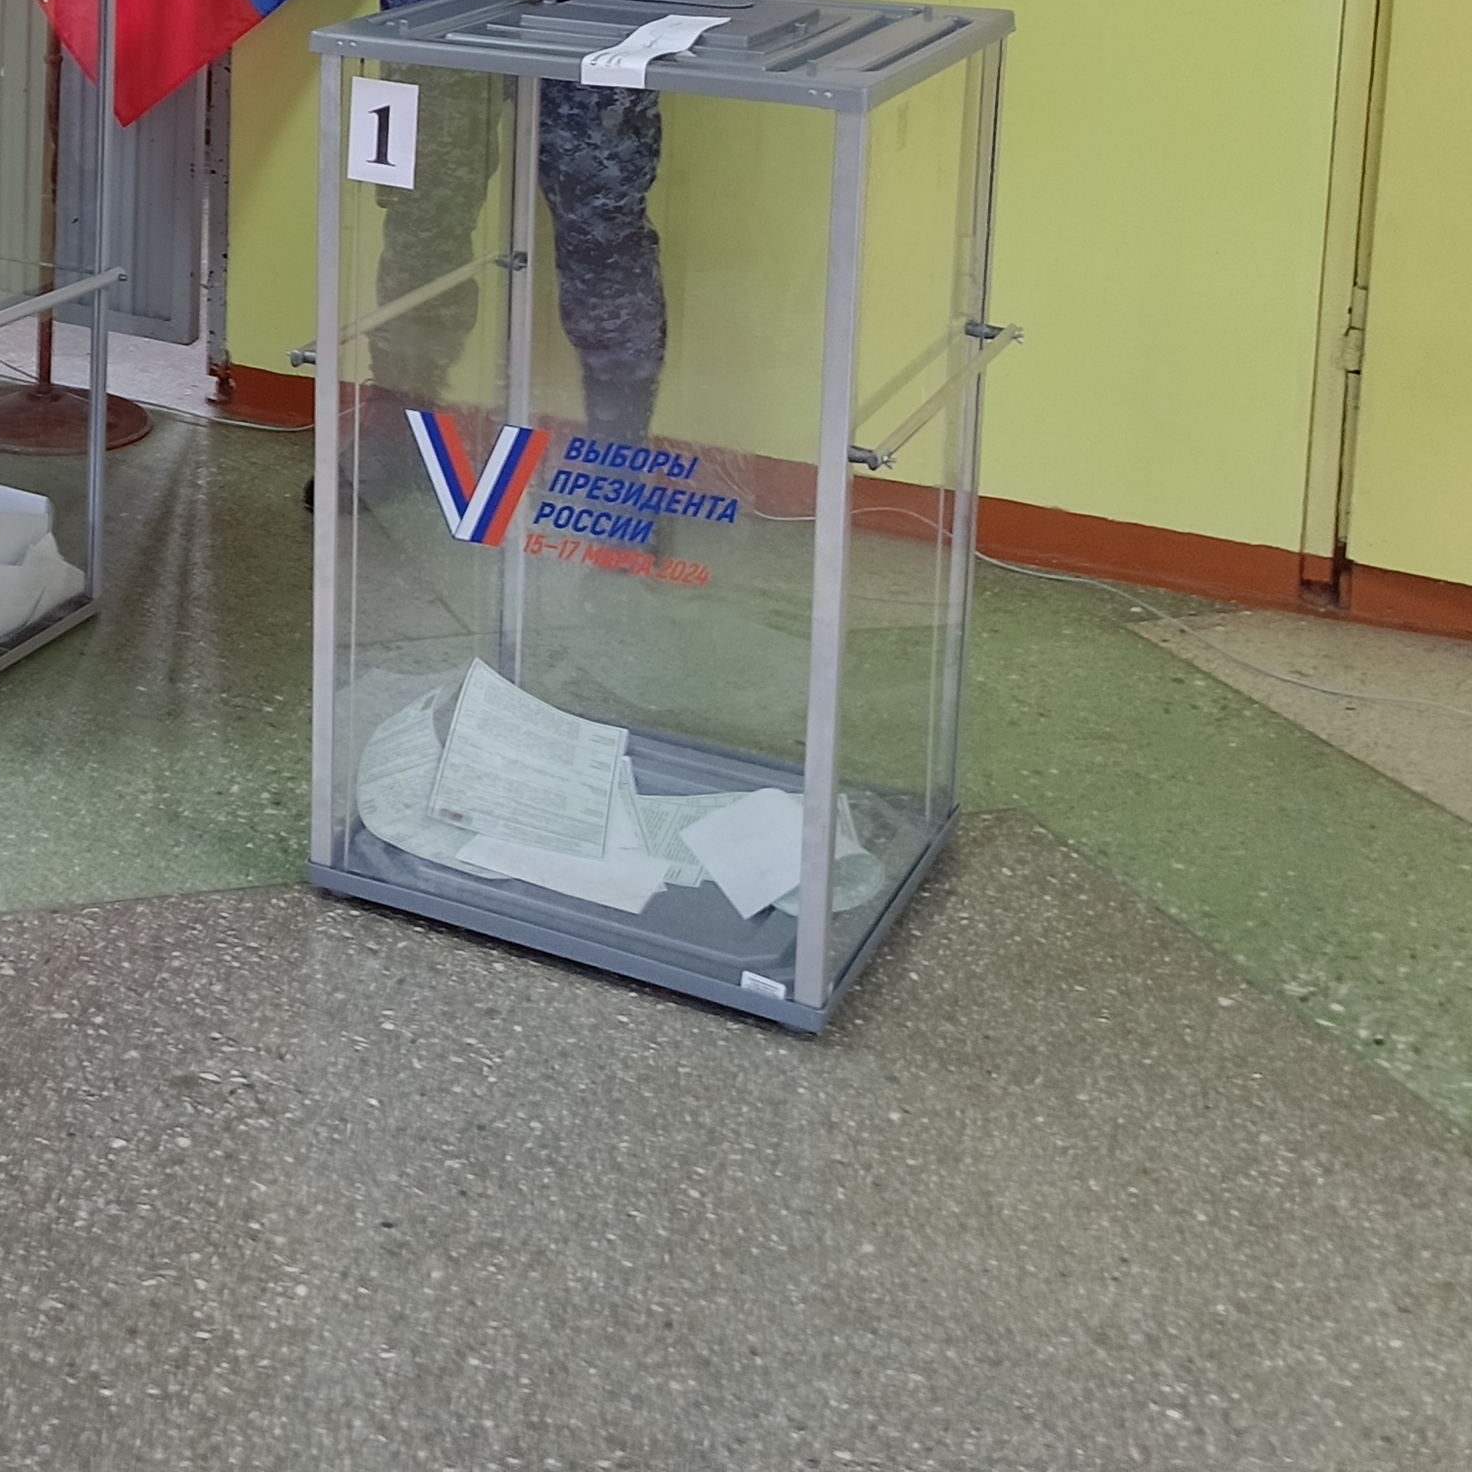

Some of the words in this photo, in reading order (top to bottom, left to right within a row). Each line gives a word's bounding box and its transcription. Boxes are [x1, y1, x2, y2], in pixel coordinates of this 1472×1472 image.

[366, 104, 397, 167] 1
[563, 436, 699, 480] ВЫБОРЫ
[548, 468, 739, 524] ПРЕЗИДЕНТА
[533, 501, 655, 544] РОССИИ
[581, 543, 656, 576] МАРТА
[657, 557, 711, 587] 2024
